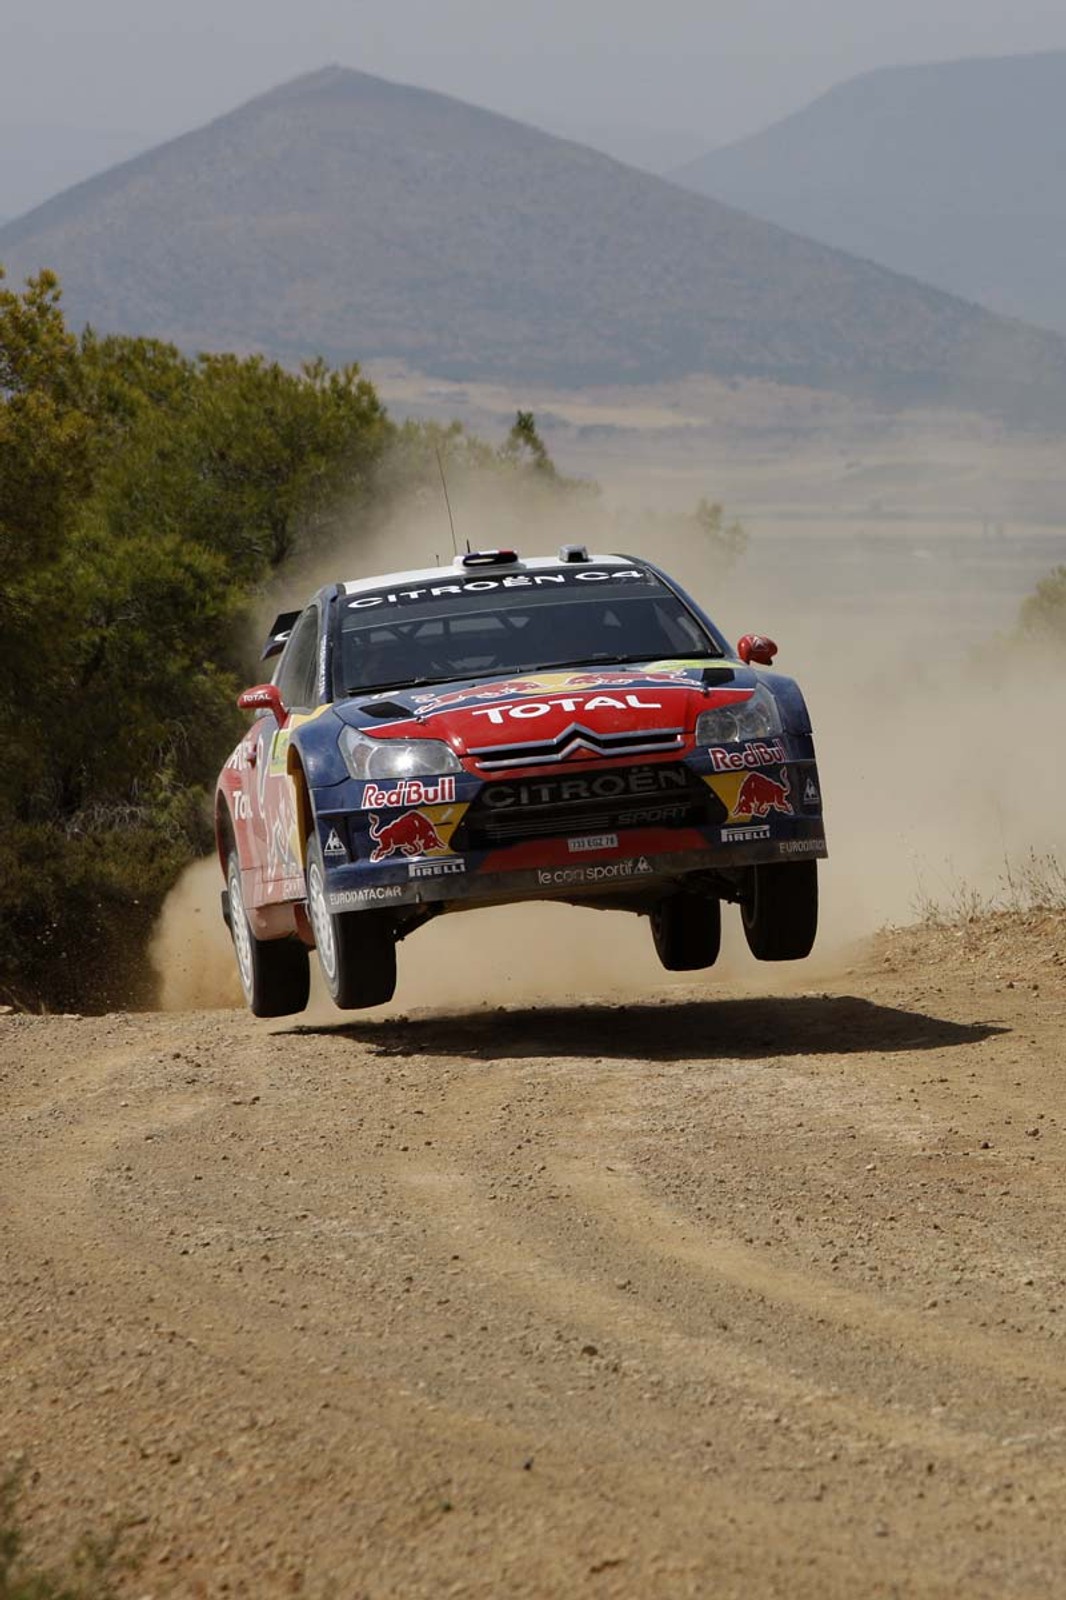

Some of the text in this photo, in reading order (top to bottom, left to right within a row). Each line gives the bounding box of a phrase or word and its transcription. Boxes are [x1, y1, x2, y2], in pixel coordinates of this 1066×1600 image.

[348, 570, 643, 608] CITROËN C4
[242, 693, 271, 702] TOTAL
[472, 695, 662, 724] TOTAL
[708, 743, 760, 772] Red
[361, 776, 456, 809] Red Bull
[481, 766, 688, 807] CITROËN
[618, 806, 691, 825] SPORT
[720, 824, 770, 843] PIRELLI
[408, 858, 466, 877] PIRELLI
[537, 869, 552, 884] le
[586, 859, 633, 881] sportif
[329, 885, 402, 905] EURODATACAR
